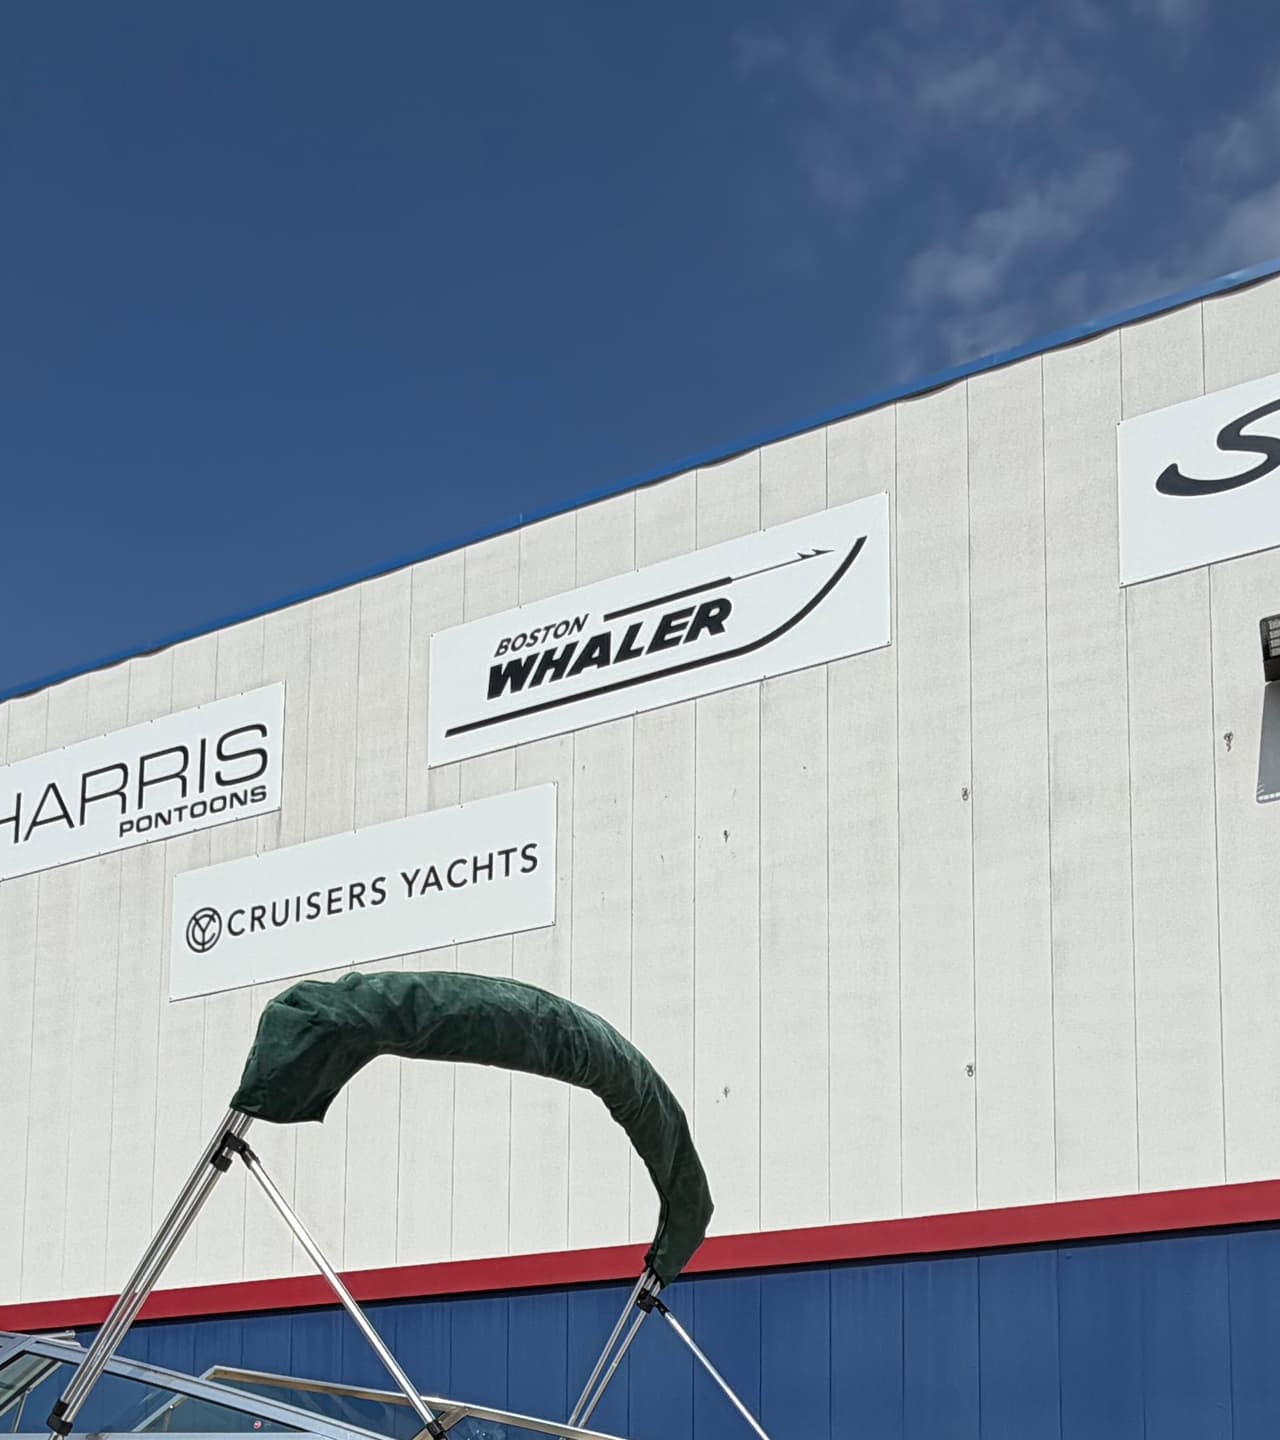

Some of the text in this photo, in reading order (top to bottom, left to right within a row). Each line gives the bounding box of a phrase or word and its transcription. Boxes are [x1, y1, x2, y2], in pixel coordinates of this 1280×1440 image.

[486, 597, 733, 700] WHALER
[493, 613, 590, 657] BOSTON
[119, 785, 268, 838] PONTOONS
[227, 876, 387, 936] CRUISERS
[400, 842, 539, 897] YACHTS
